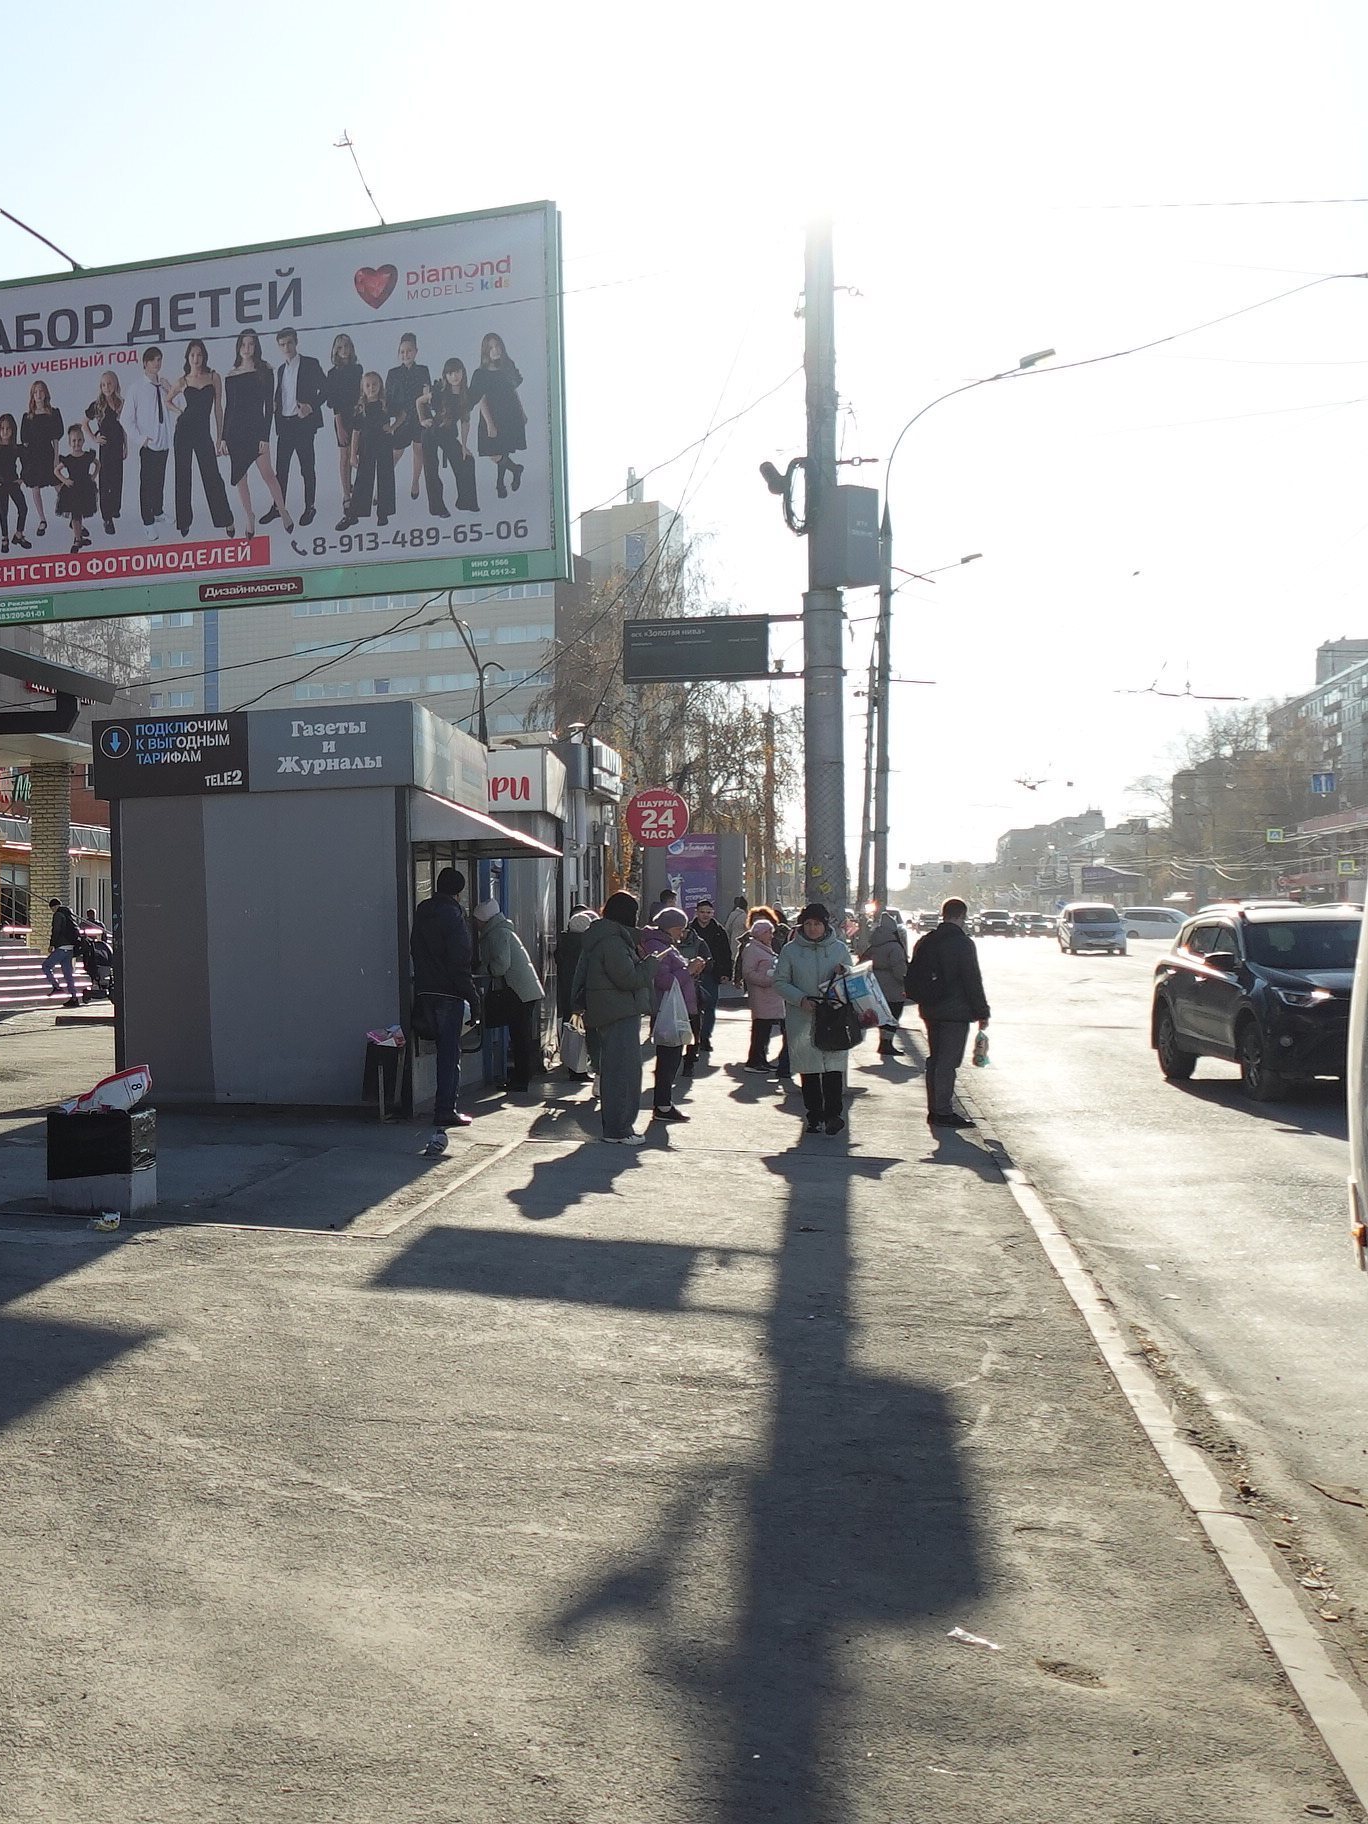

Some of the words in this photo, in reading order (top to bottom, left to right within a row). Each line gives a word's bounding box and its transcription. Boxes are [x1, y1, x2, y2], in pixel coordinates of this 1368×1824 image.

[407, 282, 474, 300] MODELS
[480, 276, 510, 291] kids
[127, 267, 303, 344] ДЕТЕЙ
[31, 352, 105, 375] УЧЕБНЫЙ
[108, 350, 139, 366] ГОД
[312, 519, 529, 556] 8-913-489-65-06
[86, 542, 252, 576] ФОТОМОДЕЛЕЙ
[135, 719, 229, 737] ПОДКЛЮЧИМ
[290, 720, 368, 738] Газеты
[136, 738, 145, 751] К
[148, 734, 231, 751] ВЫГОДНЫМ
[321, 740, 337, 753] и
[136, 750, 202, 766] ТАРИФАМ
[277, 754, 383, 776] Журналы
[204, 769, 243, 788] TELE2
[636, 800, 679, 808] ШАУРМА
[641, 809, 676, 829] 24
[641, 830, 676, 839] ЧАСА
